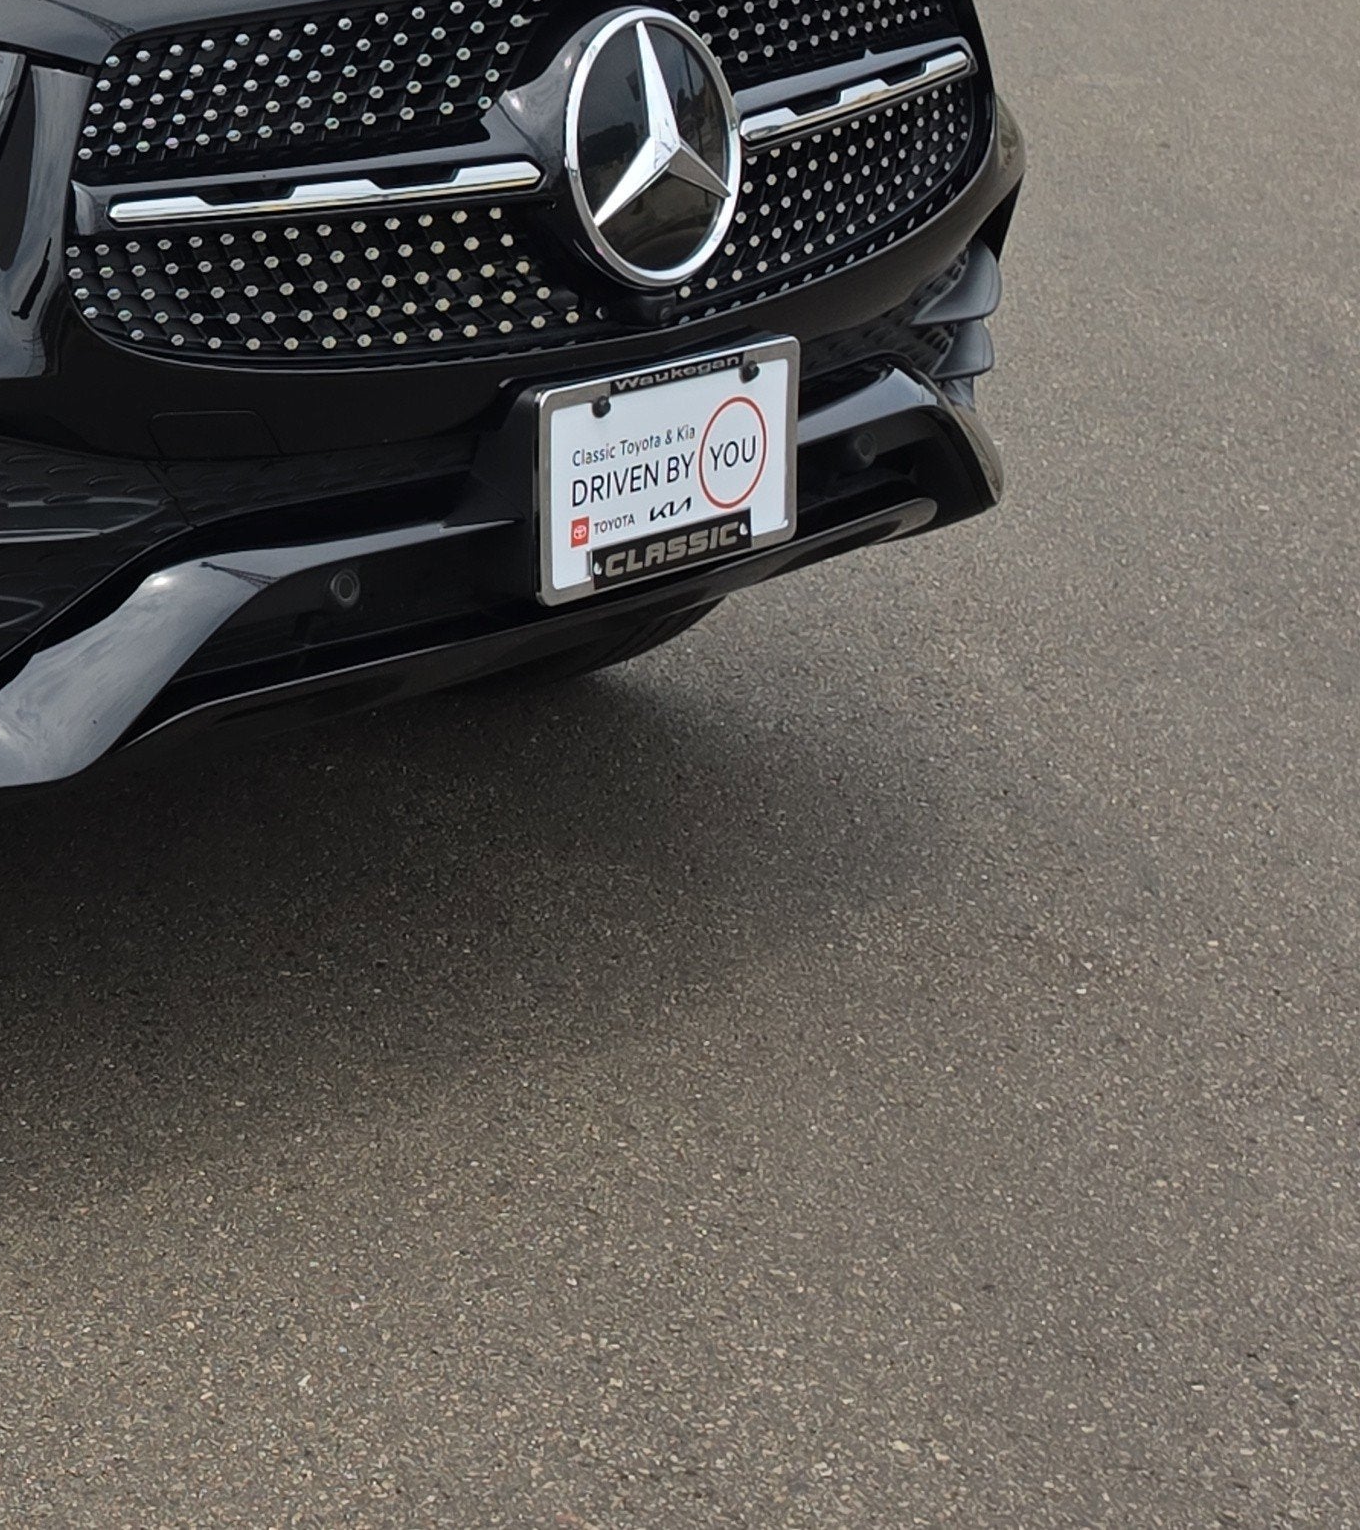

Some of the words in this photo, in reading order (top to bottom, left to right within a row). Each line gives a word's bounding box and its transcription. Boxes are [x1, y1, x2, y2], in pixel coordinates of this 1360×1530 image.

[614, 355, 741, 391] Waukegan
[572, 444, 616, 468] Classic
[619, 434, 662, 457] Toyota
[665, 429, 672, 444] &
[676, 424, 696, 442] Kia
[571, 460, 659, 508] DRIVEN
[666, 450, 696, 484] BY
[709, 435, 757, 471] YOU
[593, 513, 636, 536] TOYOTA
[604, 521, 740, 578] CLASSIC
